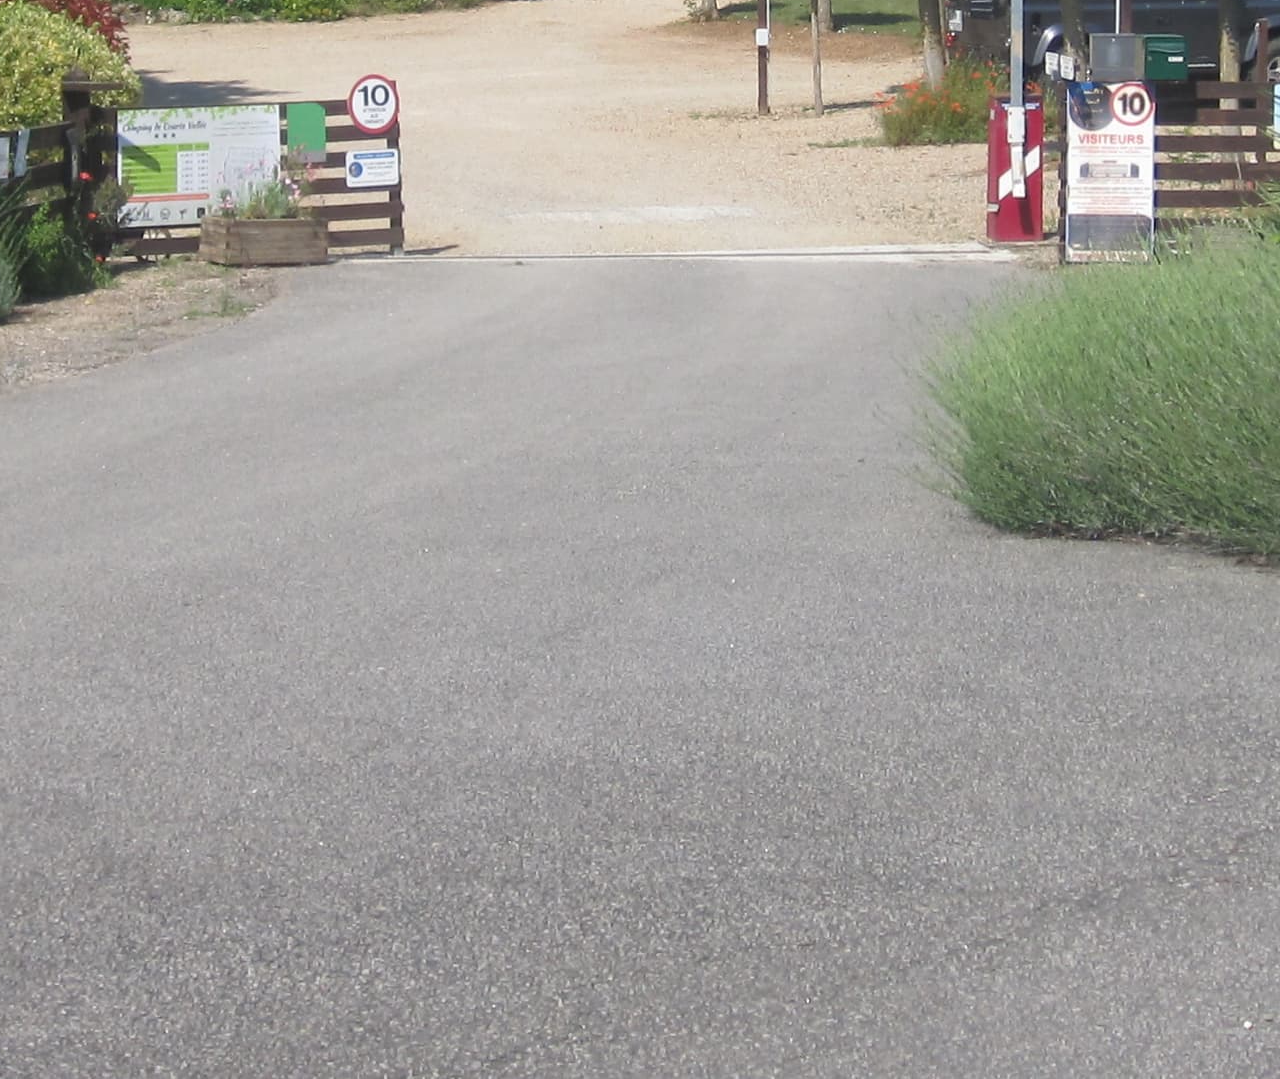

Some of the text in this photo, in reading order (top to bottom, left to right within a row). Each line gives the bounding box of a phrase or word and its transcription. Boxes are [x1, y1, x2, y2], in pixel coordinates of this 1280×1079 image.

[357, 84, 390, 107] 10
[1117, 91, 1146, 116] 10
[1078, 134, 1144, 145] VISITEURS
